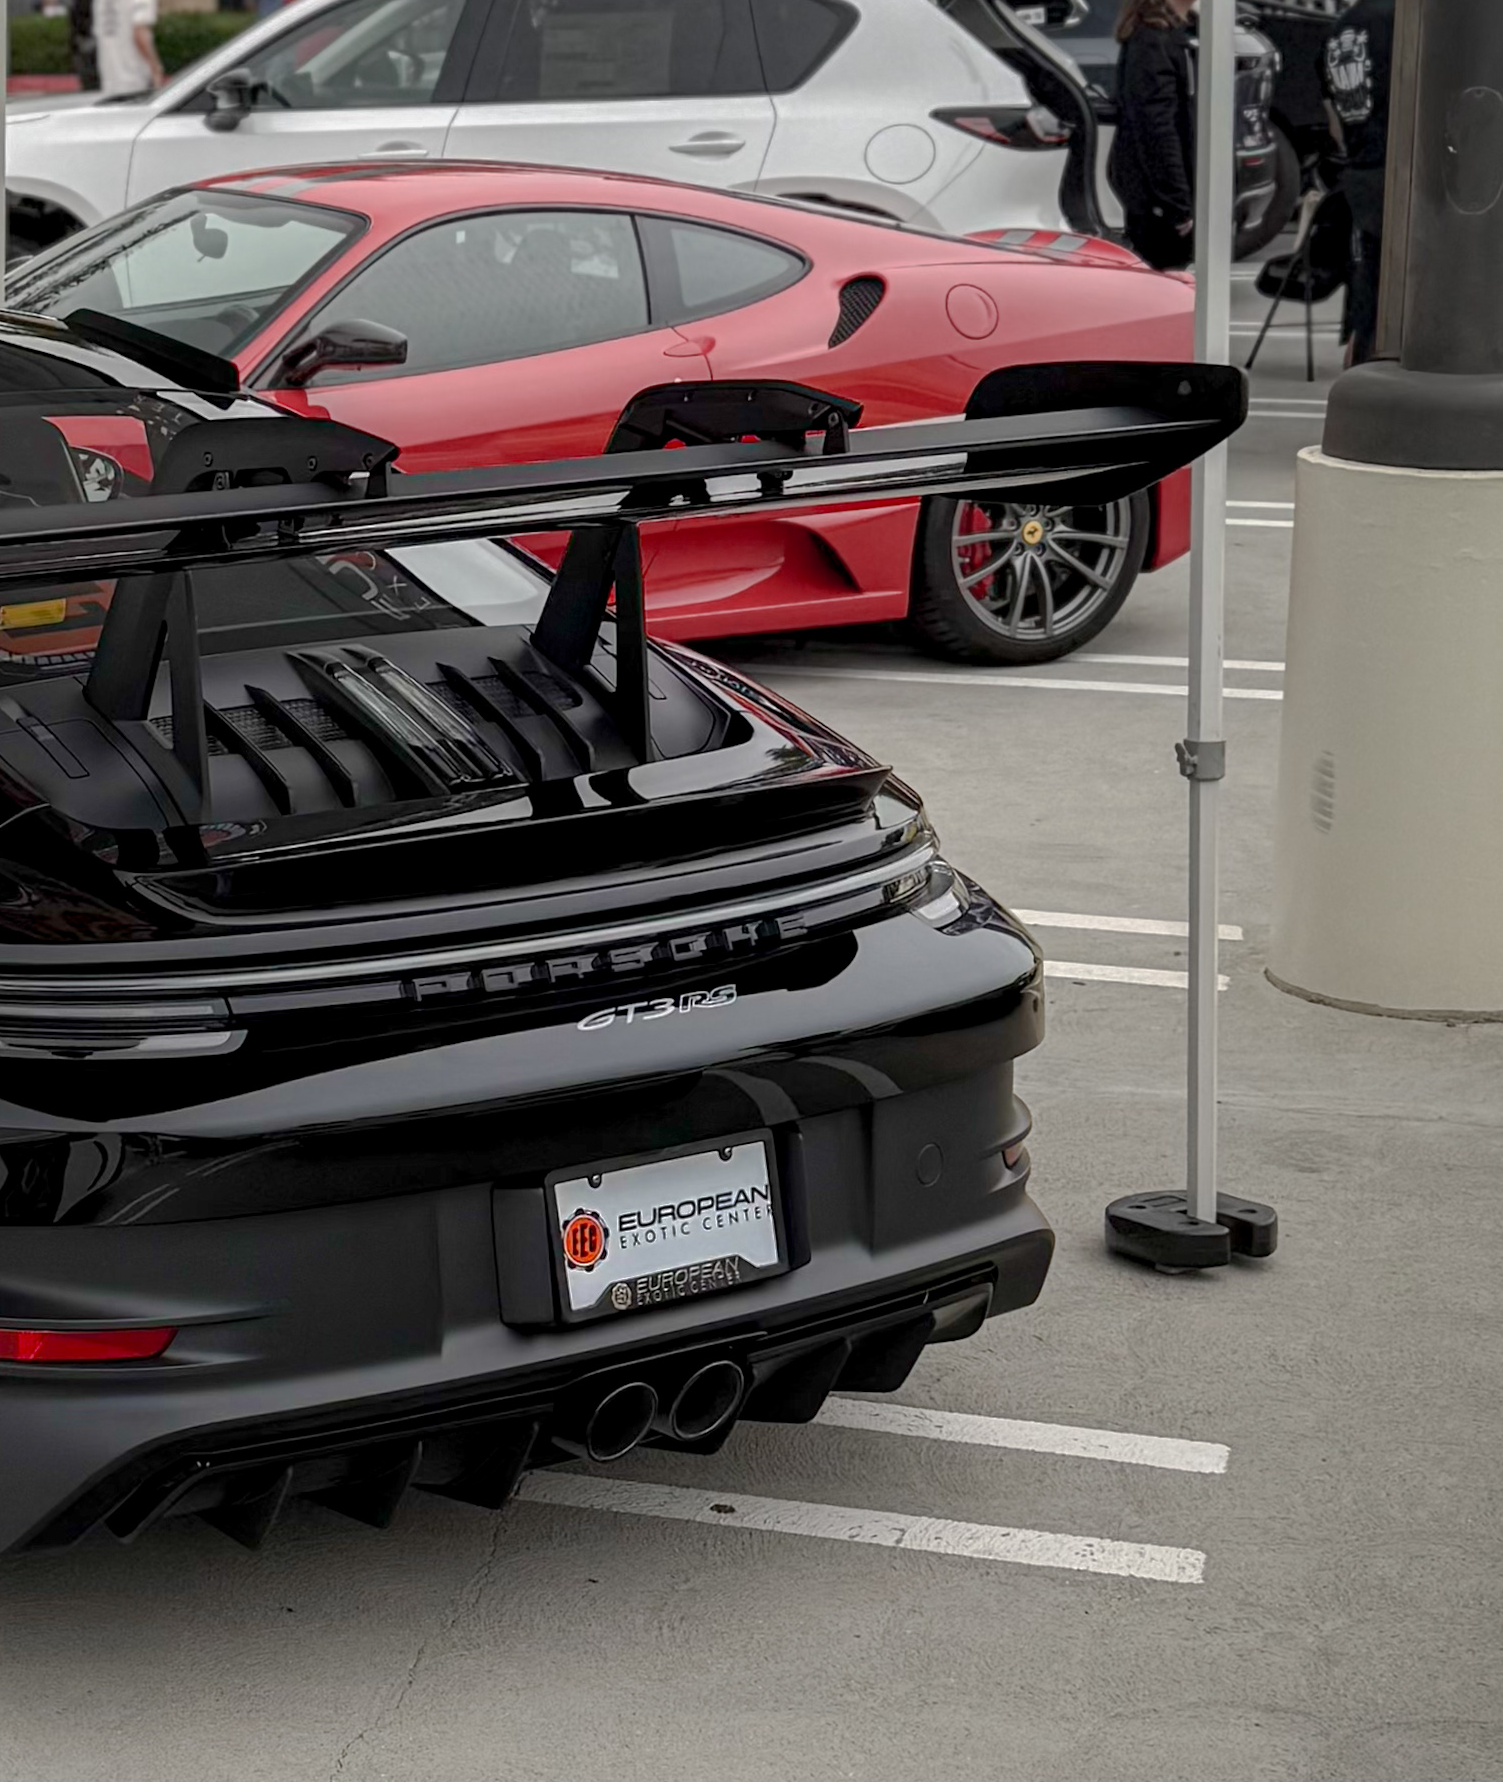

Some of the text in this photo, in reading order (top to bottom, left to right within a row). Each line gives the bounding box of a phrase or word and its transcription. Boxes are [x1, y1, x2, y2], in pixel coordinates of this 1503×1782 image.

[412, 917, 809, 1002] PORSCHE
[618, 1184, 770, 1231] EUROPEAN
[620, 1204, 774, 1249] EXOTIC CENTER
[636, 1256, 740, 1293] EUROPEAN
